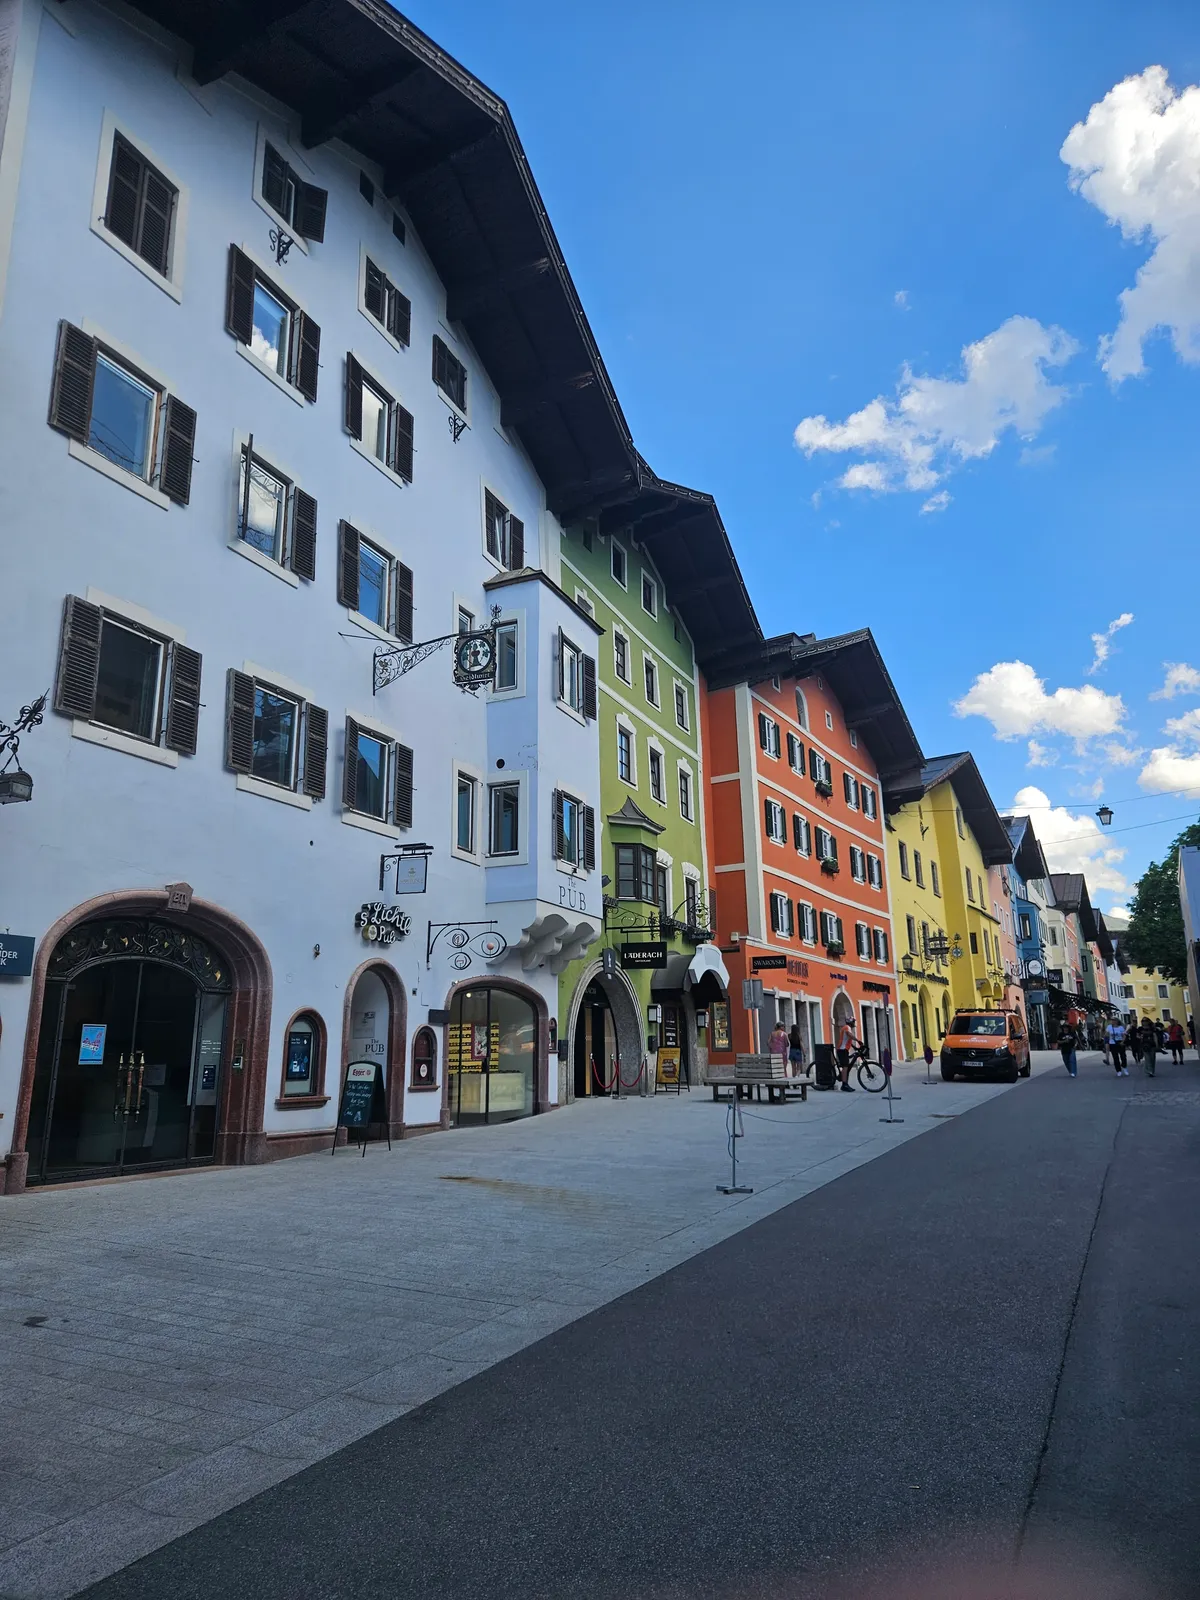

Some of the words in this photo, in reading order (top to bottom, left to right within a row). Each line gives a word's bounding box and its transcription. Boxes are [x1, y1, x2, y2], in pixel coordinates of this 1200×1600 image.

[559, 885, 587, 911] PUB
[377, 925, 397, 944] Pub
[0, 950, 18, 959] DER
[365, 1043, 385, 1053] PUB
